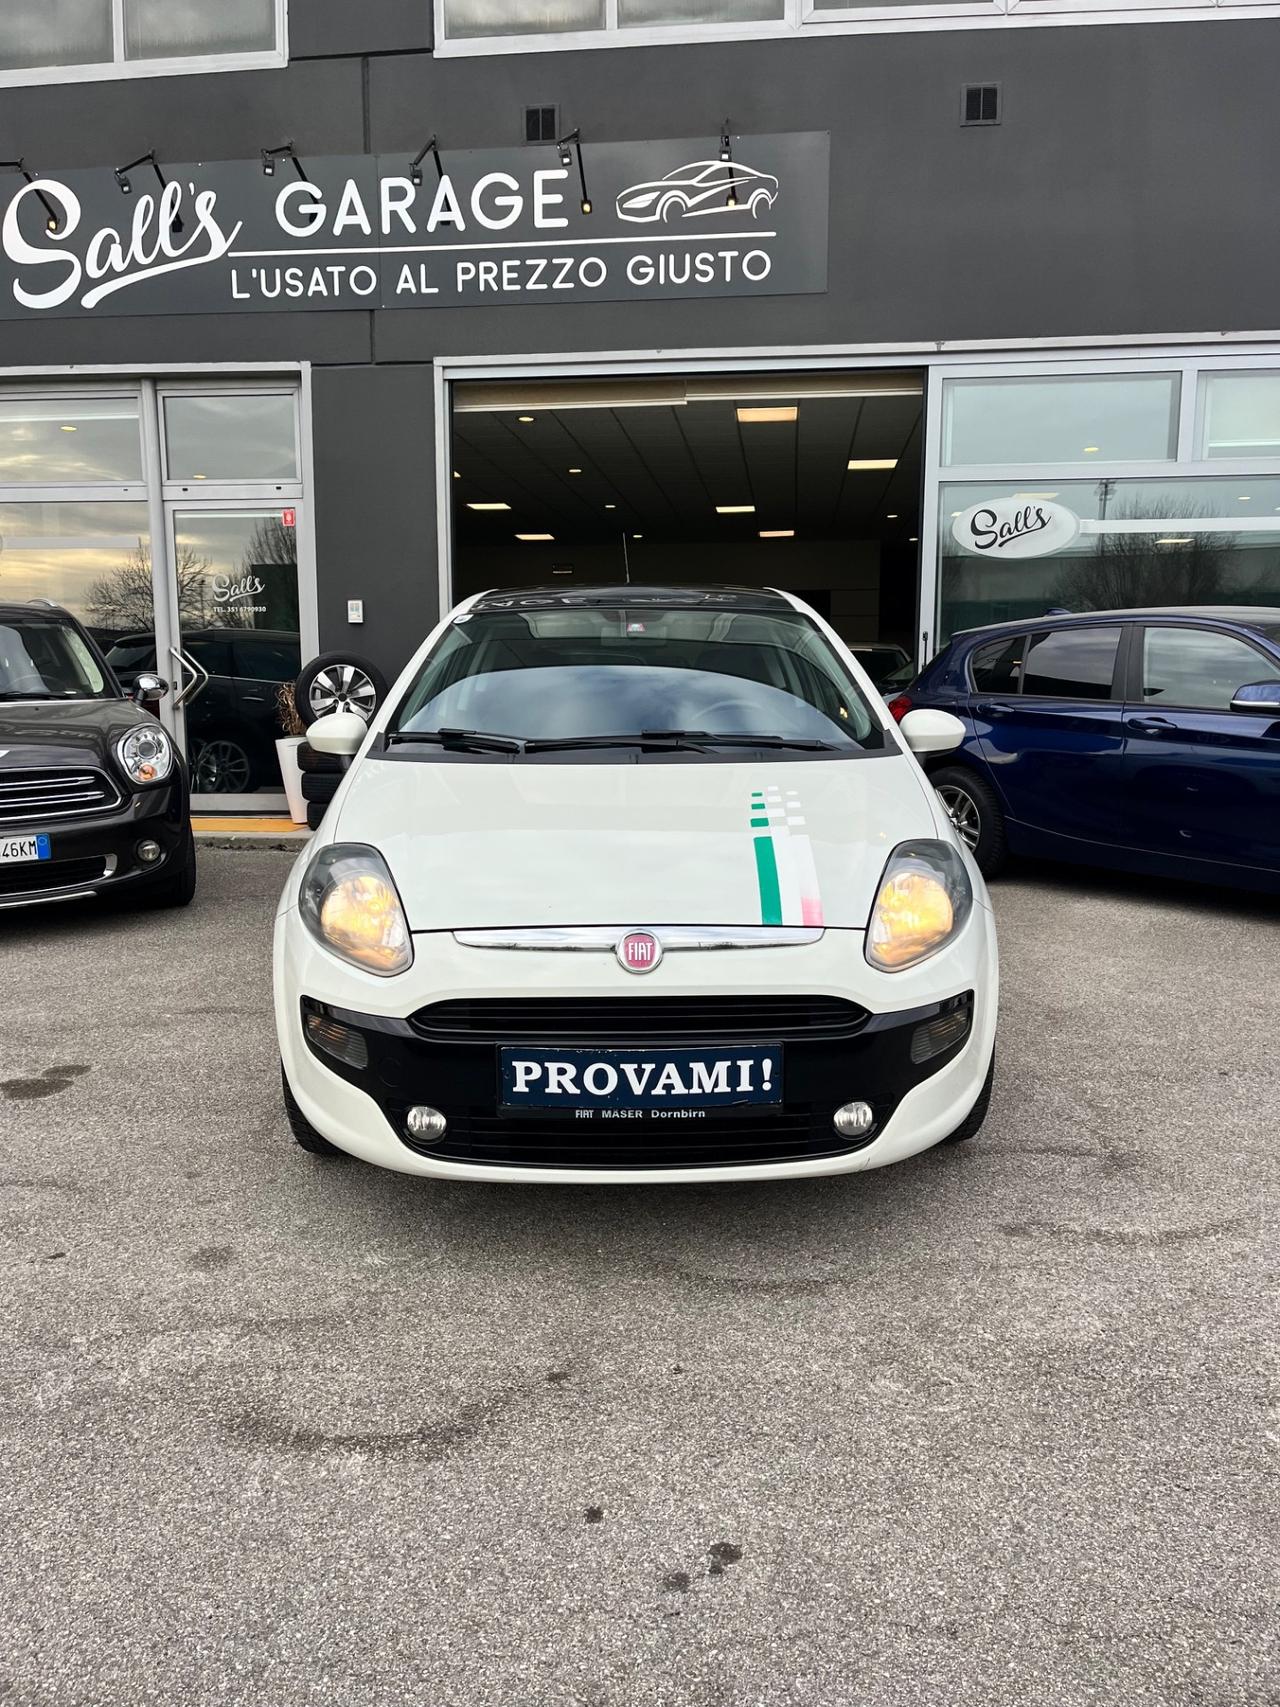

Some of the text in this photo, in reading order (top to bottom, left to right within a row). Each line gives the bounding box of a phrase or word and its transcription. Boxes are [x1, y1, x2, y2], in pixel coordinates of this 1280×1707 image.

[2, 169, 569, 309] Sall's GARAGE
[231, 249, 771, 299] L'USATO AL PREZZO GIUSTO
[970, 505, 1052, 550] Sall's
[212, 574, 266, 602] Sall's
[628, 942, 653, 961] FIAT
[511, 1058, 773, 1096] PROVAMI!
[575, 1109, 595, 1119] FIAT
[651, 1109, 706, 1118] Dornbirn
